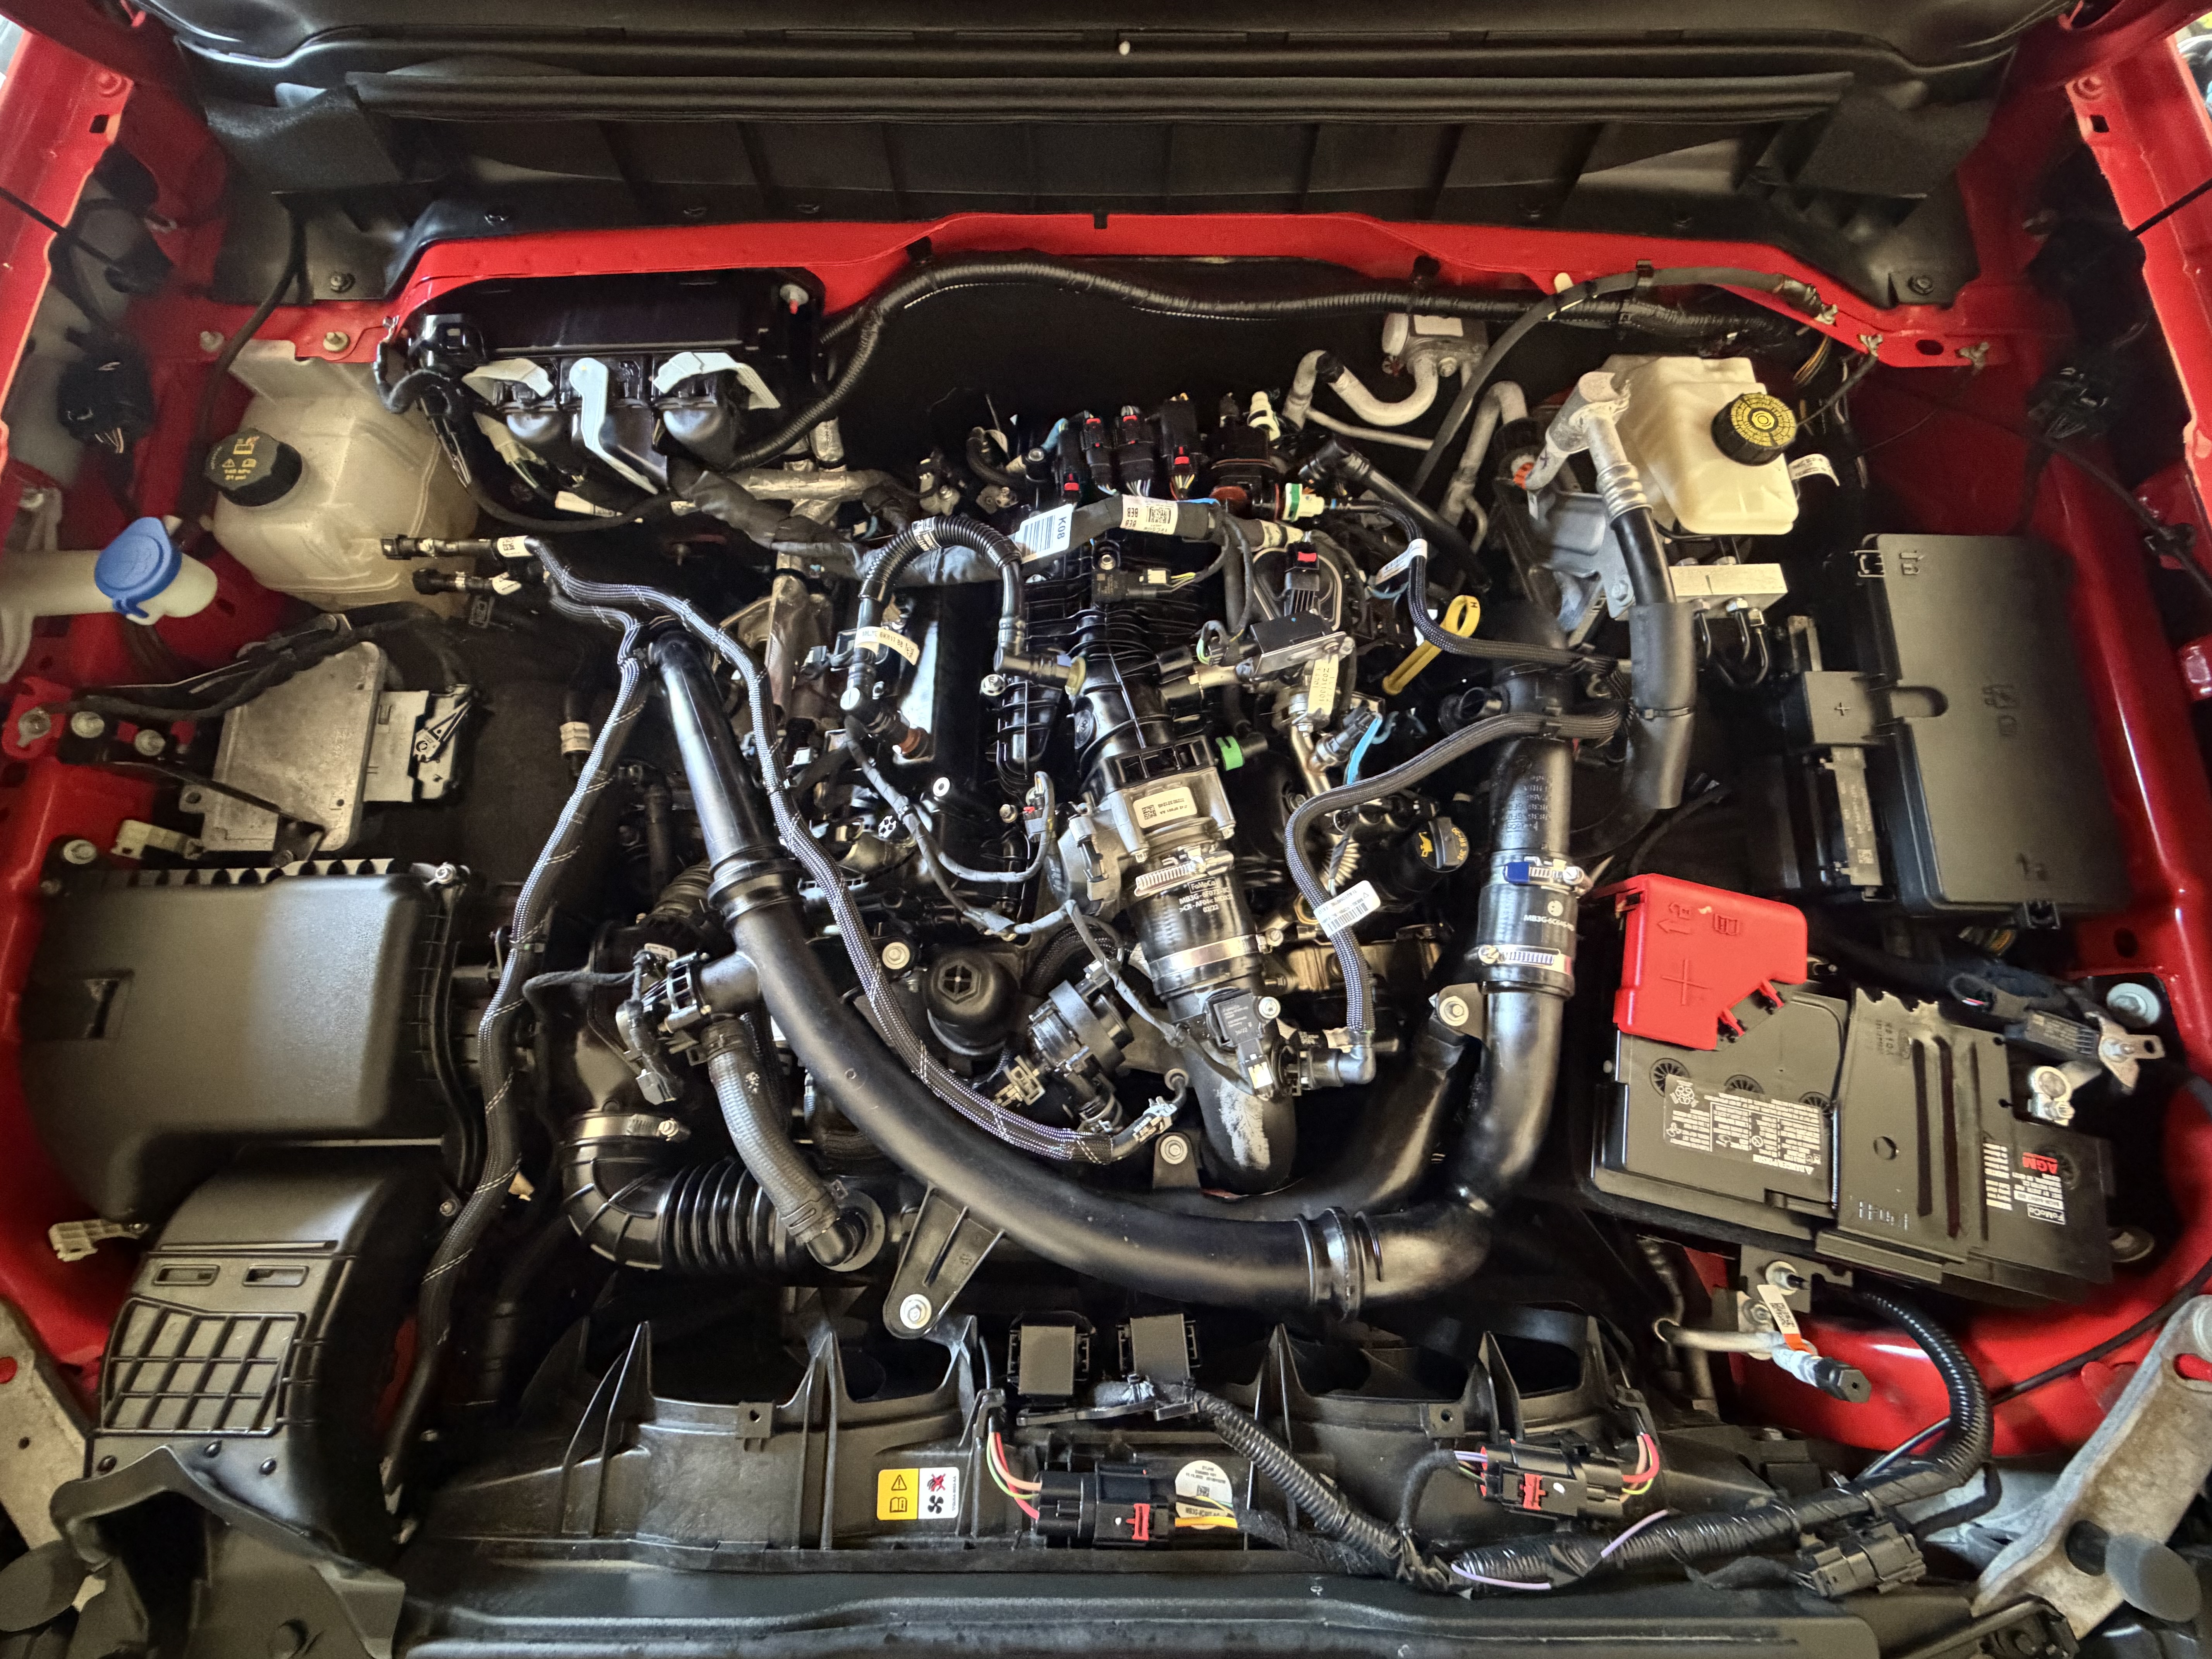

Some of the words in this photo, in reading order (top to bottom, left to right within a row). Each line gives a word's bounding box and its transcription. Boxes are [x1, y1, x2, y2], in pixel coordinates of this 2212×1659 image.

[1127, 507, 1138, 517] BEB
[1056, 515, 1068, 541] K08
[1190, 880, 1216, 890] FoMoCo
[2022, 1156, 2058, 1175] AGM
[2029, 1206, 2064, 1223] FoMoCo
